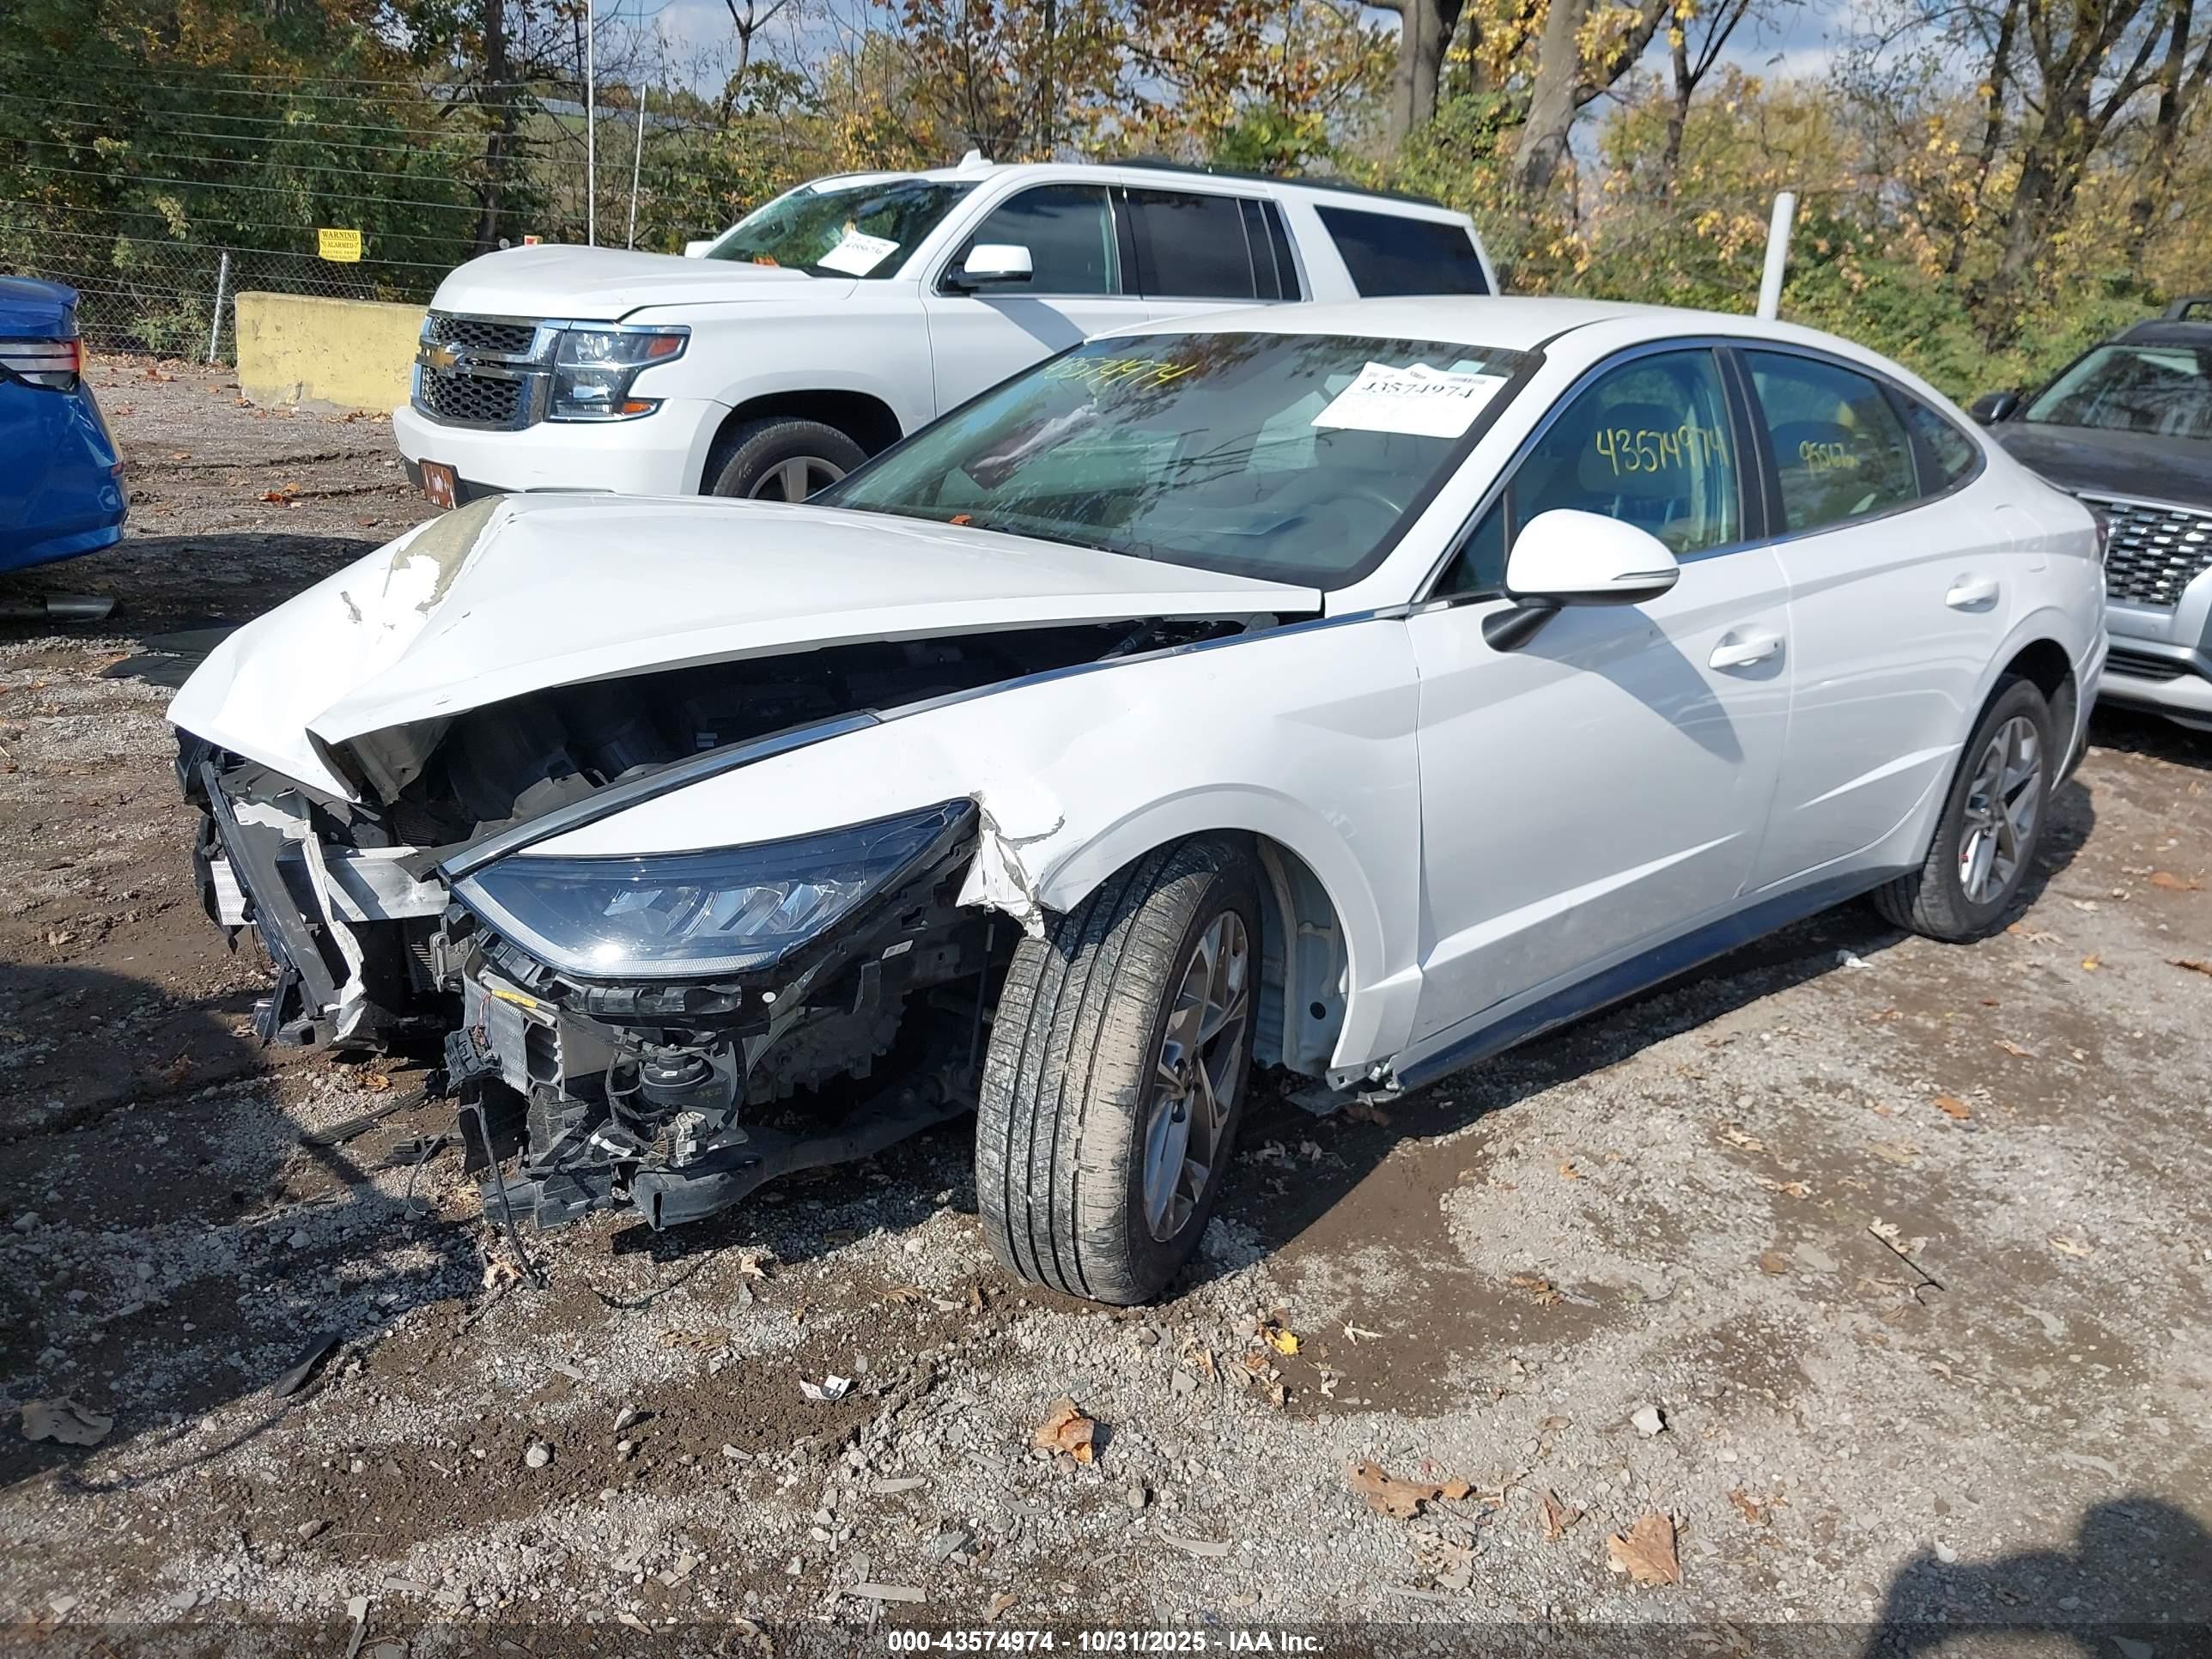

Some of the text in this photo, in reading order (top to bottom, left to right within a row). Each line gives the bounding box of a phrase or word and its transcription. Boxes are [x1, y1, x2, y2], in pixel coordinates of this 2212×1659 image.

[322, 231, 357, 240] WARNING
[1044, 356, 1197, 392] 43574974
[1362, 381, 1475, 398] 43574974
[1596, 425, 1730, 477] 43574974
